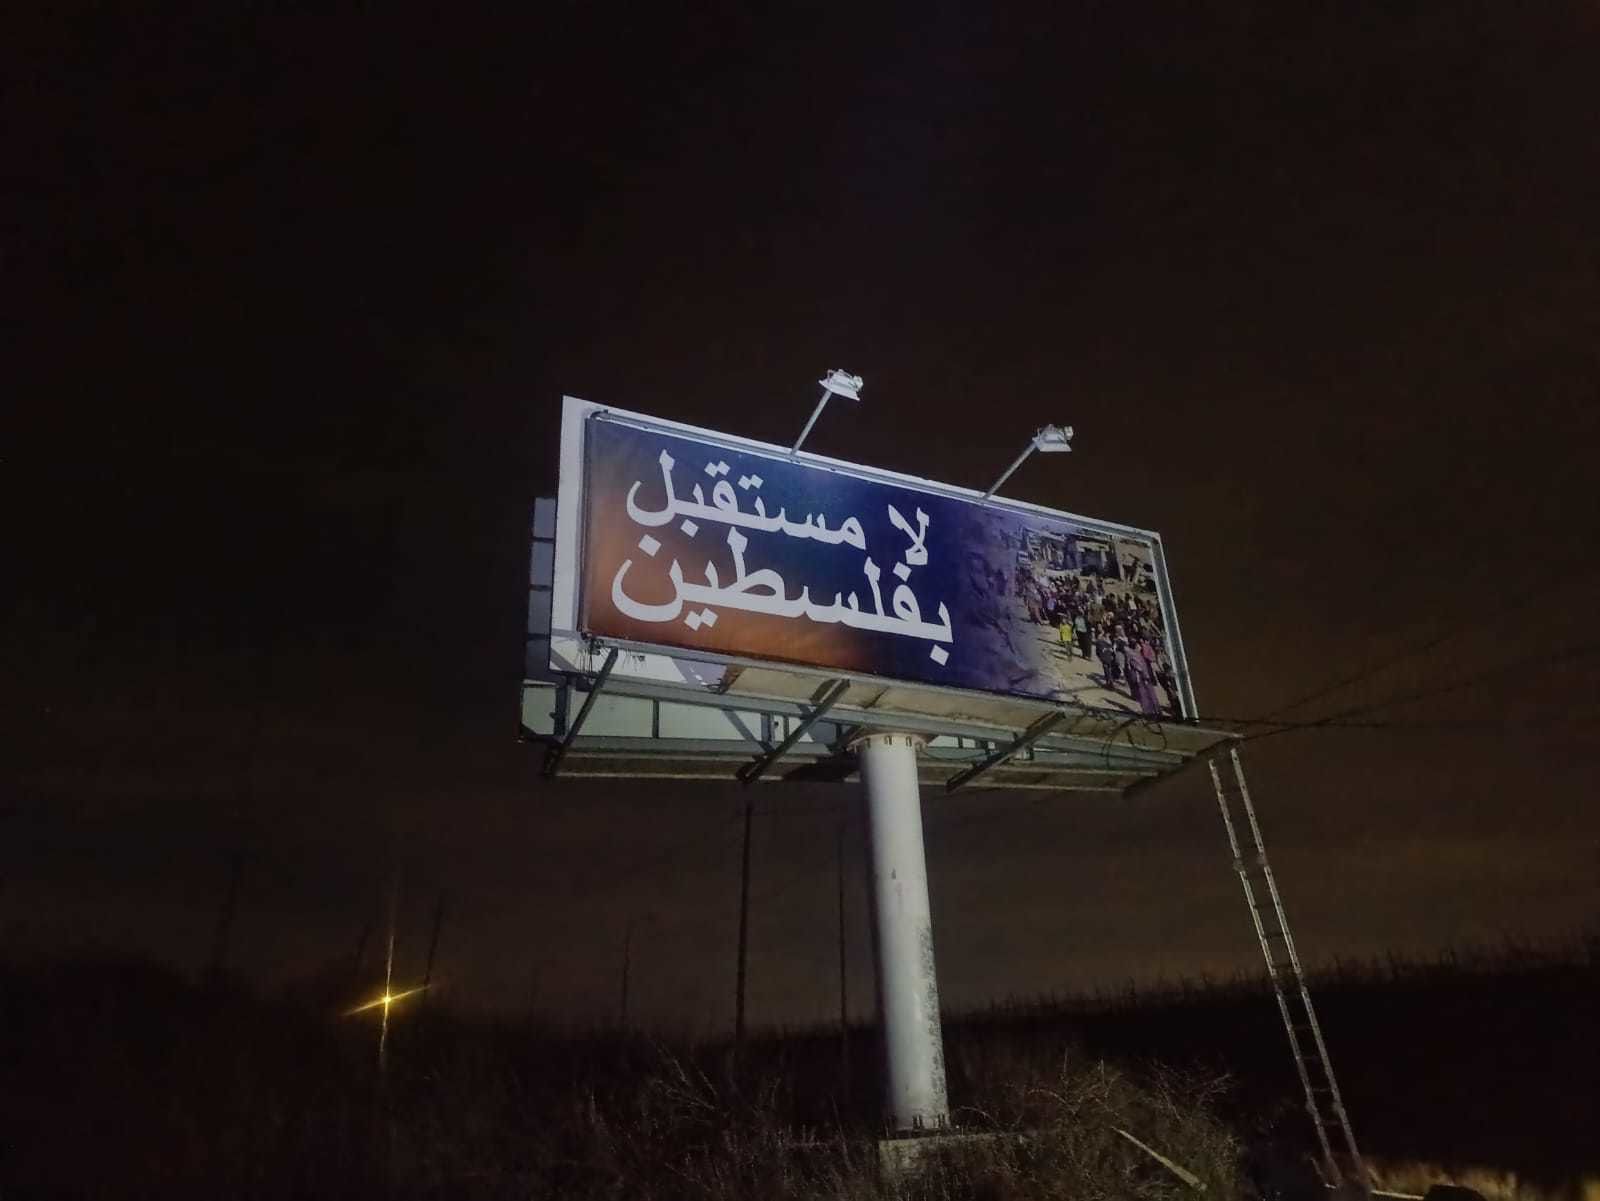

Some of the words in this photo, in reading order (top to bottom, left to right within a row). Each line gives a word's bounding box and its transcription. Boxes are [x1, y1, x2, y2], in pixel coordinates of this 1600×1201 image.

[626, 450, 866, 550] مستقبل
[888, 504, 930, 565] لا
[612, 527, 953, 666] بفلسطين
